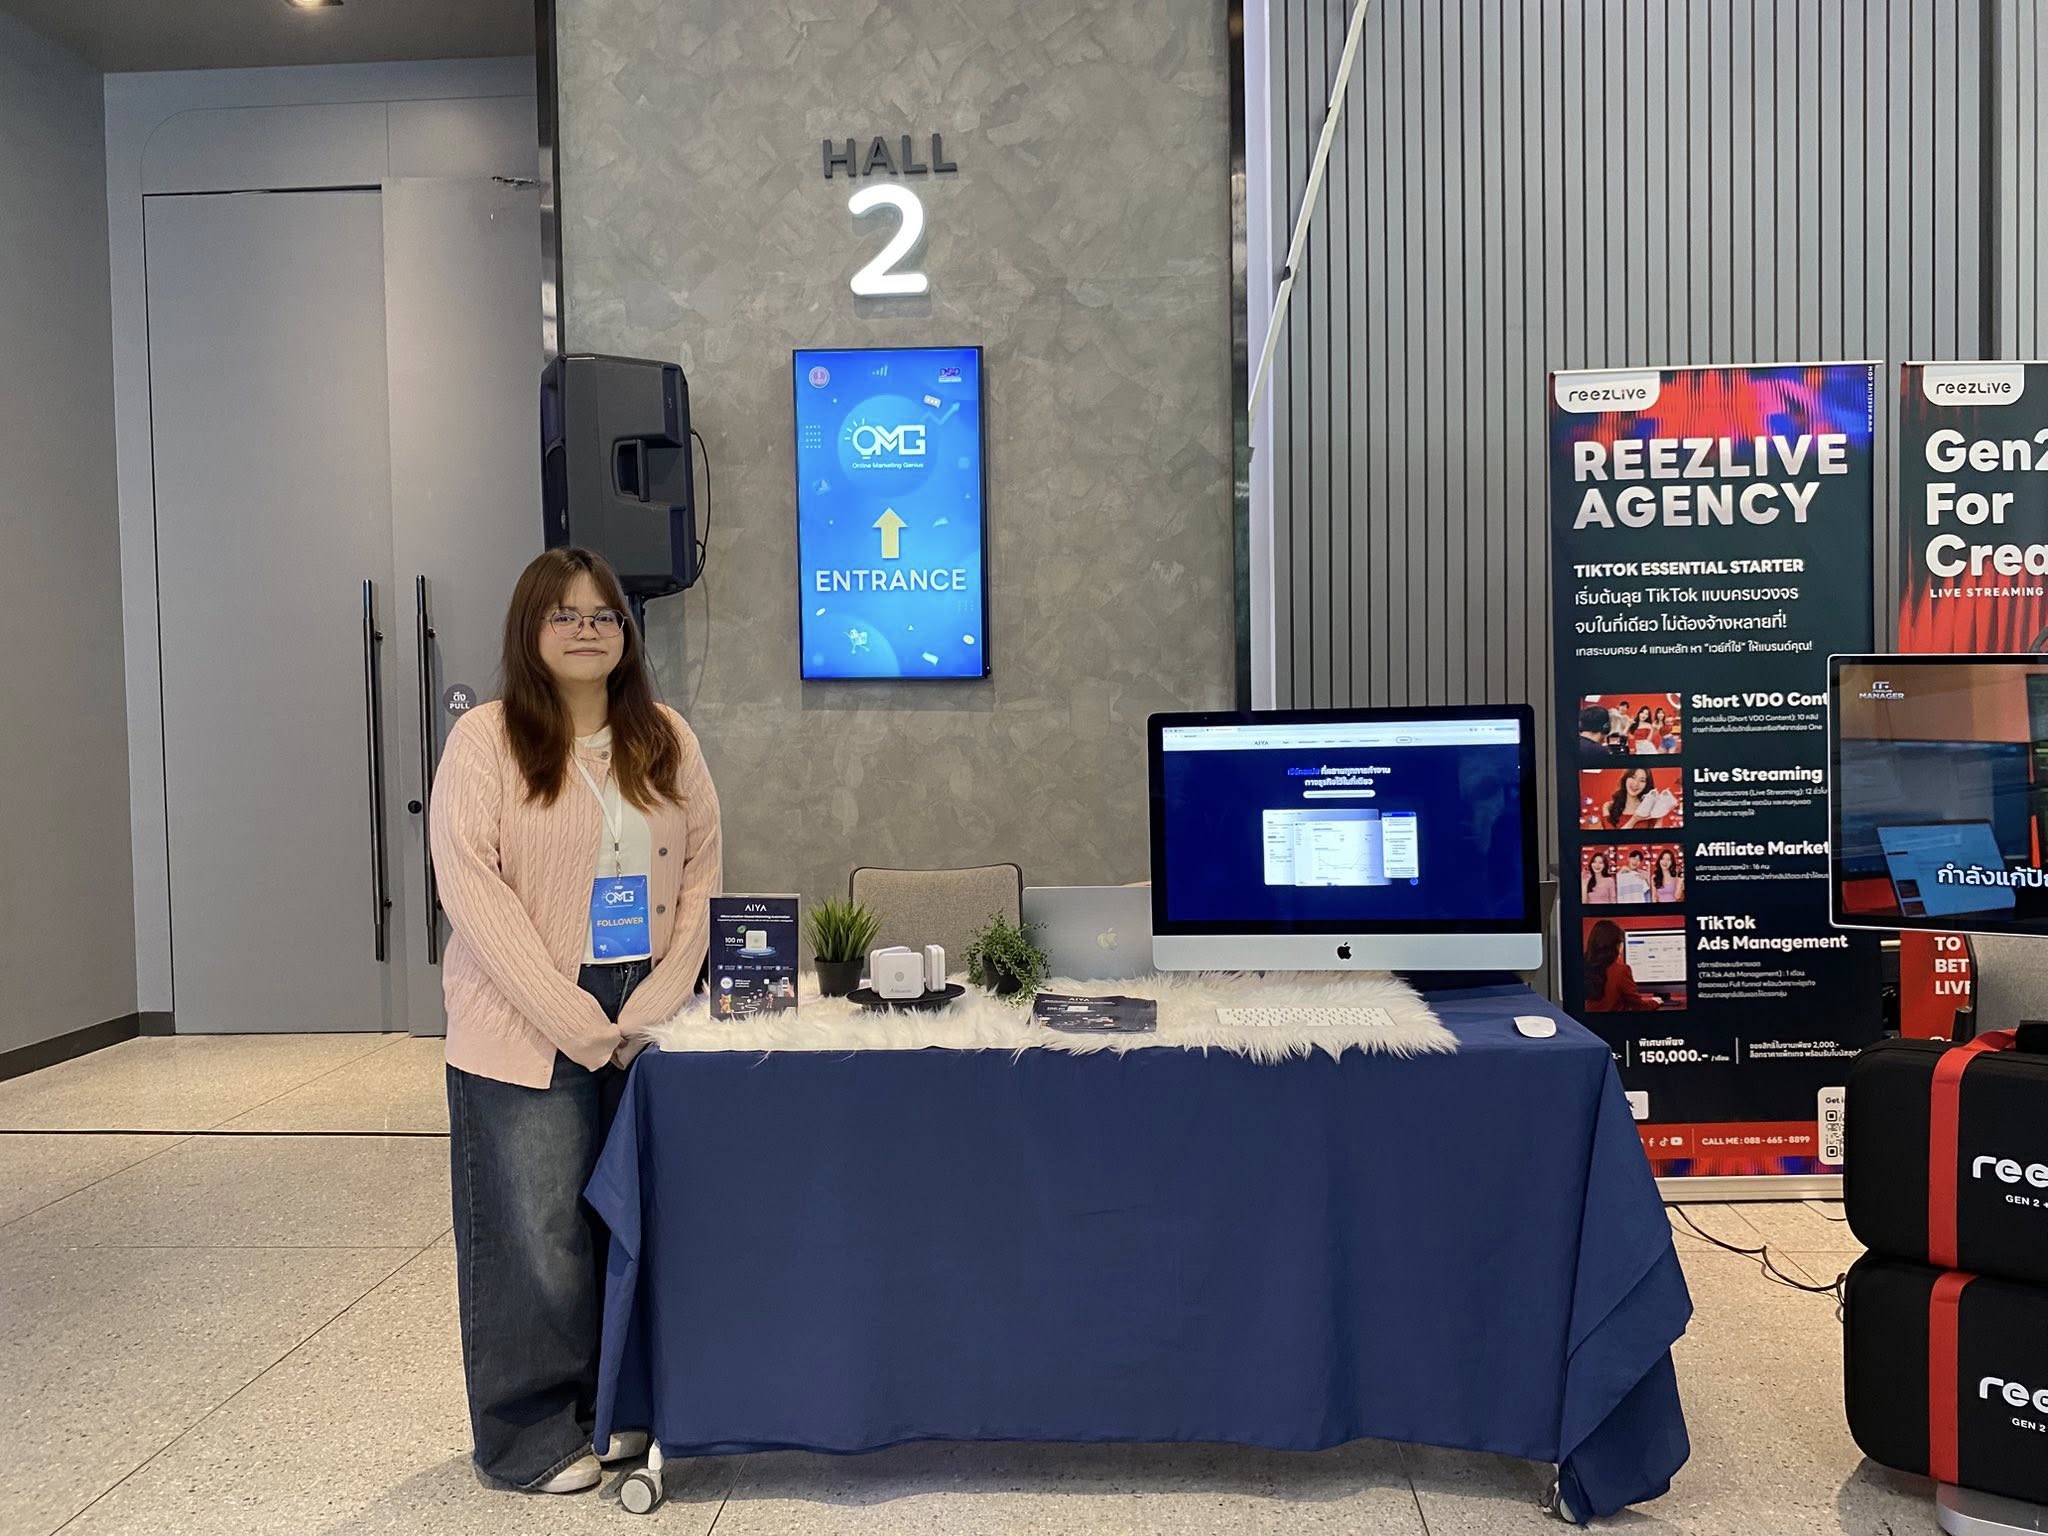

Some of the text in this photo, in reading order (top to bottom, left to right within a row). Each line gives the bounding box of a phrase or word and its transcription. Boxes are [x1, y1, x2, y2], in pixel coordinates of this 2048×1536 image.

[822, 133, 958, 179] HALL
[848, 184, 928, 296] 2
[853, 424, 926, 459] OMG
[1573, 433, 1848, 482] REEZLIVE
[1573, 481, 1820, 529] AGENCY
[1926, 482, 2014, 525] For
[1925, 533, 2048, 577] Crea
[1573, 559, 1804, 577] TIKTOK ESSENTIAL STARTER
[816, 568, 967, 592] ENTRANCE
[1575, 585, 1798, 607] เริ่มต้นลุย TikTok แบบครบวงจร
[1930, 587, 2044, 598] LIVE STREAMING
[1575, 609, 1787, 634] จบในที่เดียว ไม่ต้องจ้างหลายที่!
[1639, 644, 1648, 655] 4
[1690, 644, 1702, 653] หา
[1692, 695, 1740, 708] Short
[1742, 692, 1784, 707] VDO
[1859, 692, 1904, 700] MANAGER
[1693, 766, 1823, 783] Live Streaming
[1695, 841, 1765, 856] Affiliate
[1937, 862, 2048, 888] กำลังแก้ปั
[605, 890, 634, 905] OMG
[744, 904, 767, 912] AIYA
[597, 917, 644, 927] FOLLOWER
[1696, 915, 1756, 930] TikTok
[1697, 935, 1848, 952] Ads Management
[1934, 936, 1961, 951] TO
[1935, 958, 1969, 973] BET
[1639, 1037, 1684, 1047] พิเศษเพียง
[1639, 1049, 1709, 1065] 150,000.-
[1701, 1137, 1725, 1145] CALL
[2005, 1194, 2030, 1206] GEN
[2033, 1198, 2040, 1208] 2
[2012, 1417, 2046, 1433] GEN 2
